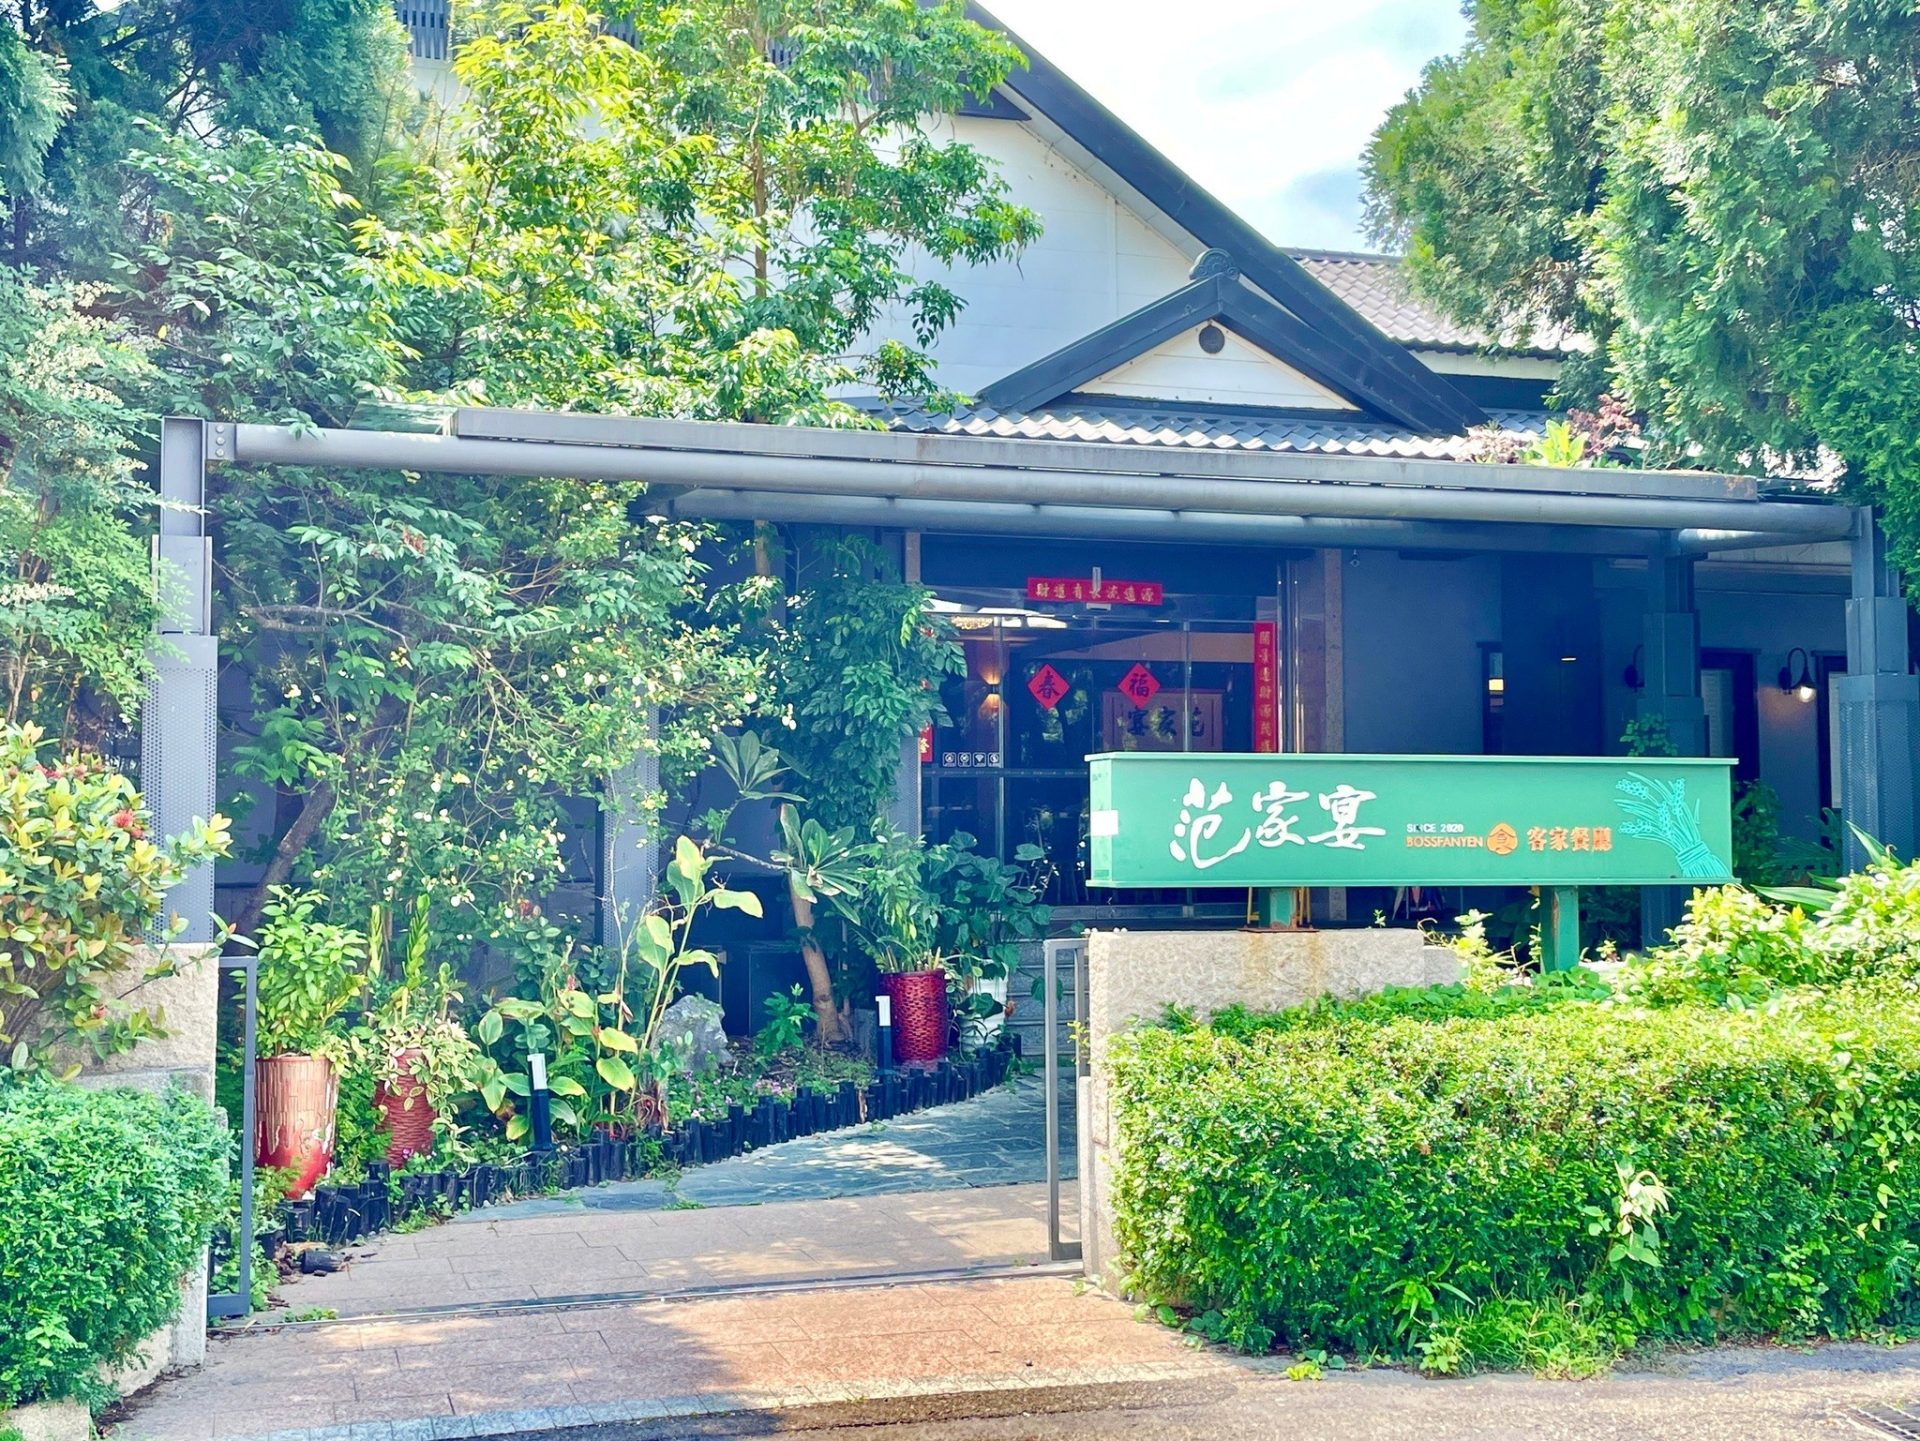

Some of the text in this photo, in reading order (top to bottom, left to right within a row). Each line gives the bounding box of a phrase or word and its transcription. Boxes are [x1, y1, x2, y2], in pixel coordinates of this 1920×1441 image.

[1037, 670, 1059, 698] 春
[1129, 673, 1150, 697] 福
[1169, 778, 1386, 869] 范家宴
[1406, 823, 1464, 833] SINCE 2020
[1406, 836, 1484, 847] BOSSFANYEN
[1527, 826, 1612, 851] 客家餐廳
